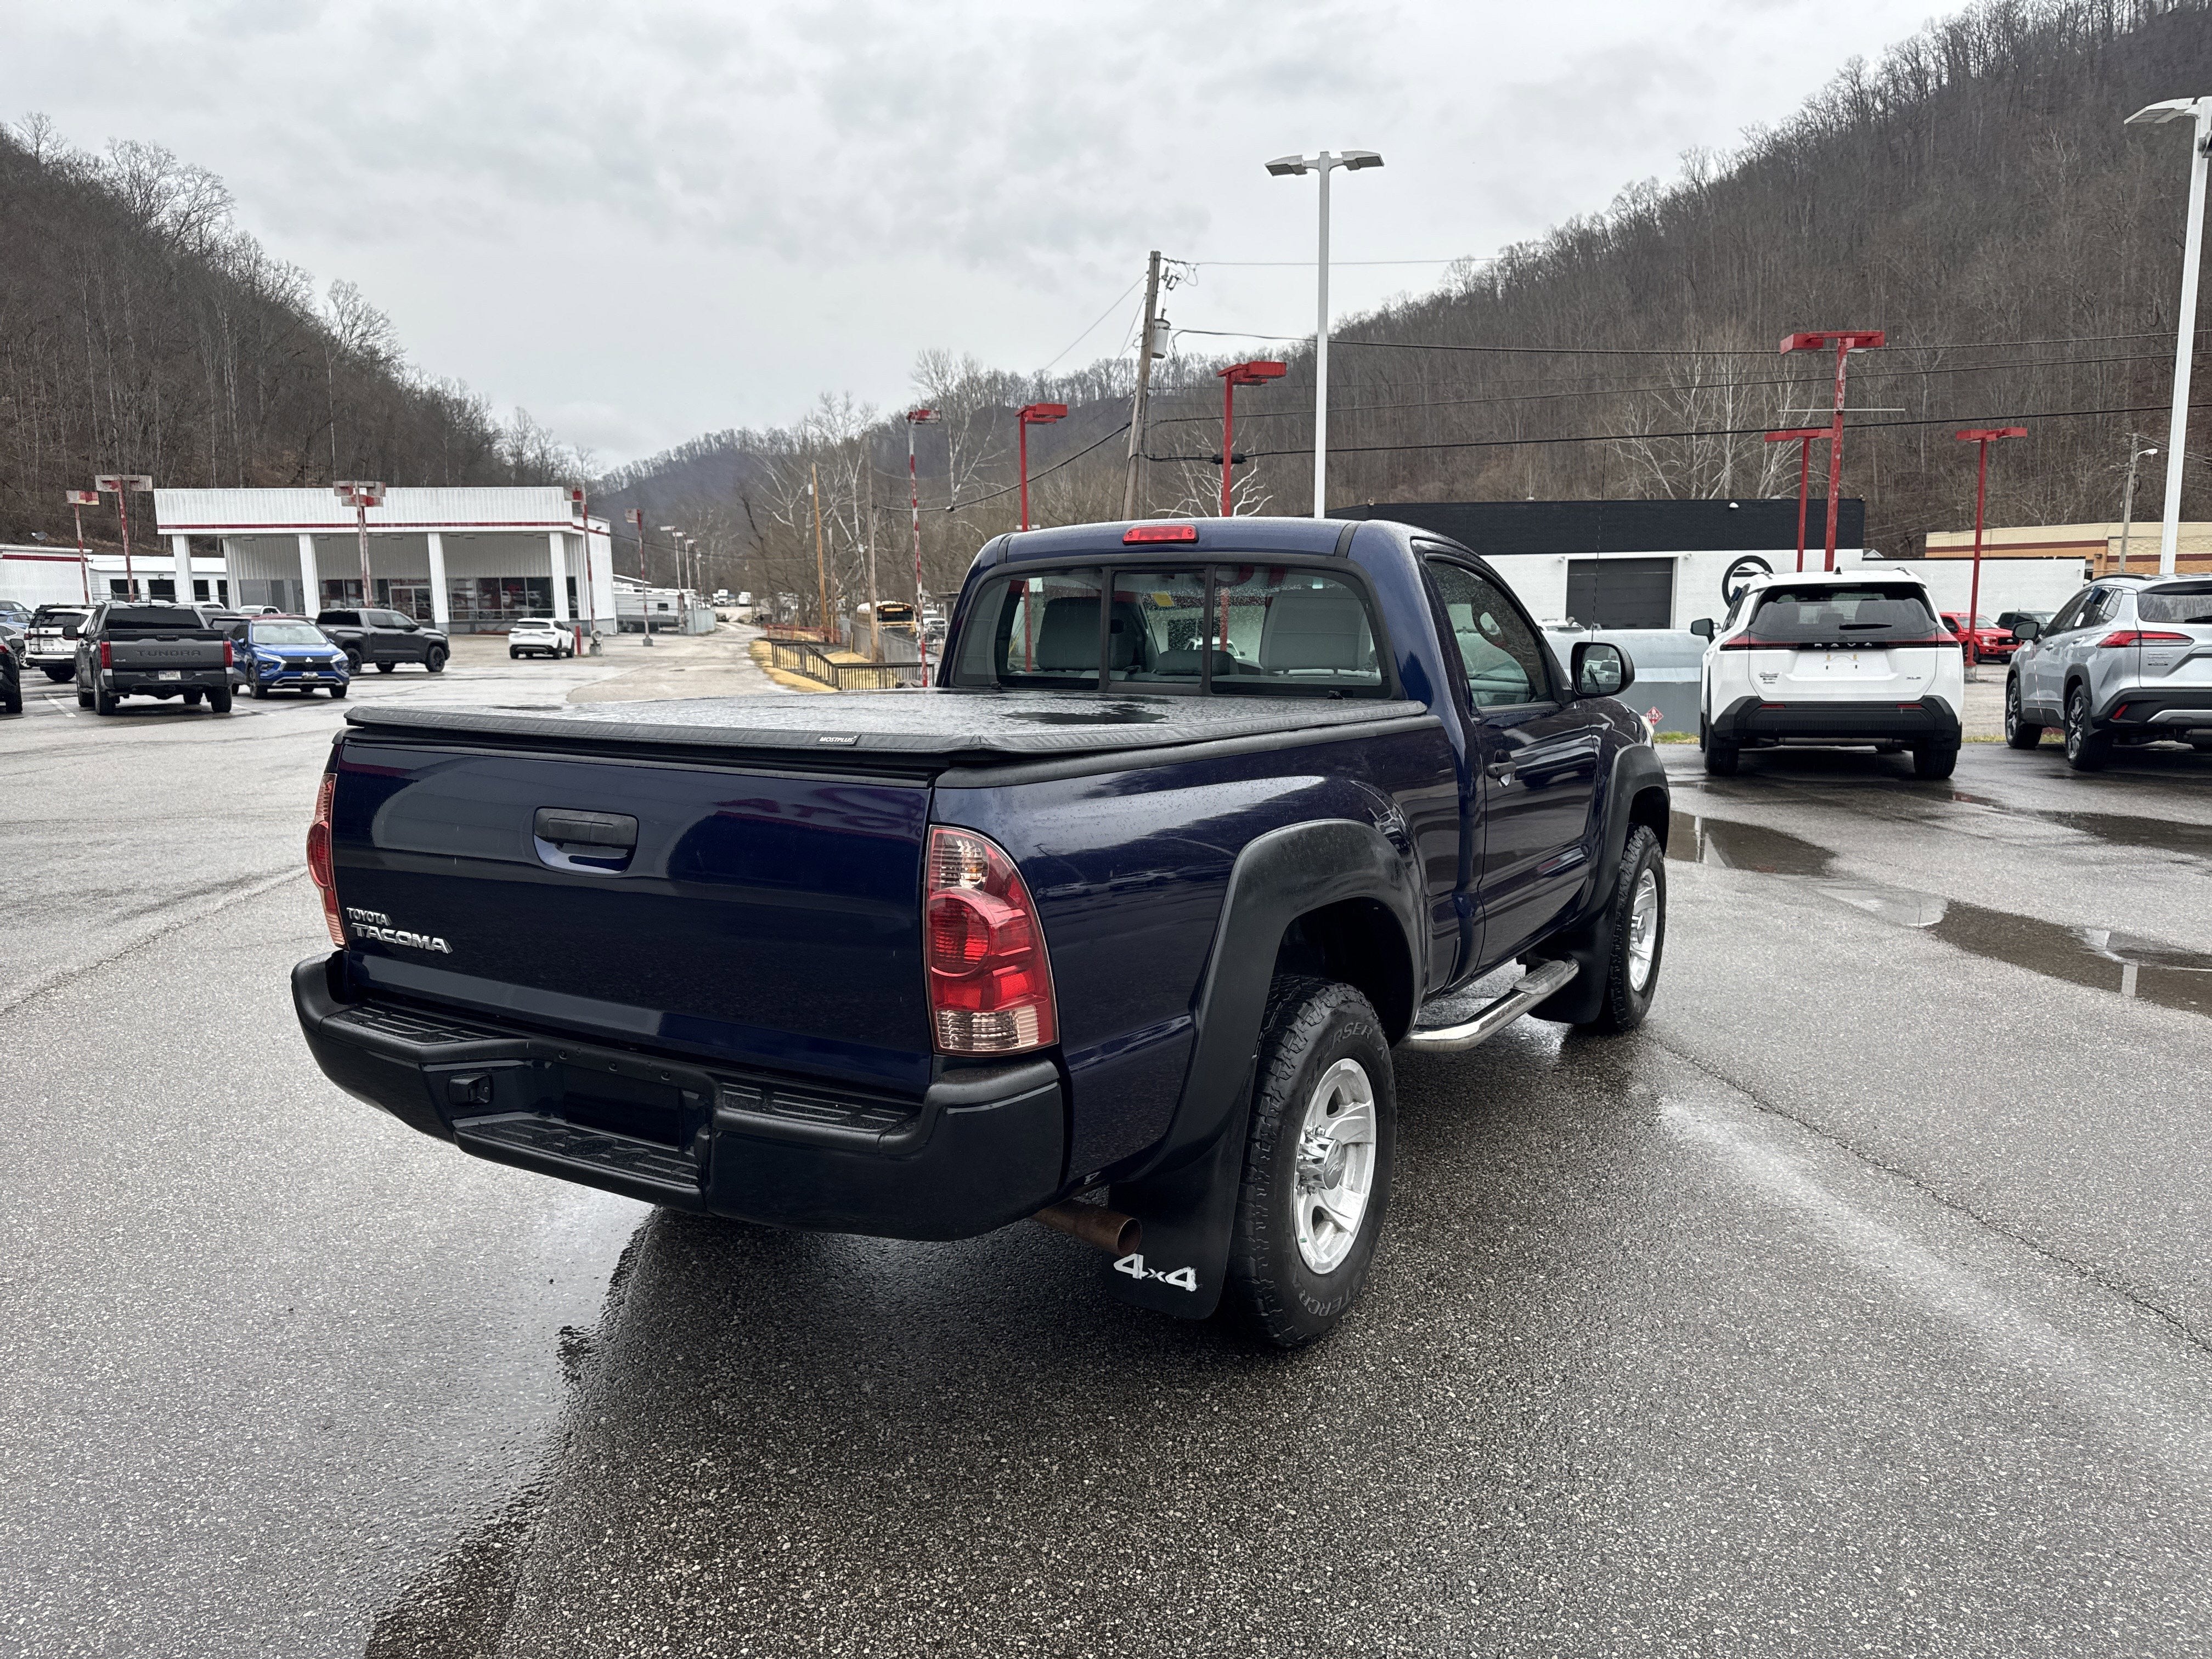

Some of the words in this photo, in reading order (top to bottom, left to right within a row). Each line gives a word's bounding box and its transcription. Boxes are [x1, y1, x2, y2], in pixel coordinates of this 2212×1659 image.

[346, 907, 392, 926] TOYOTA
[350, 923, 453, 954] TACOMA
[1113, 1253, 1198, 1292] 4x4
